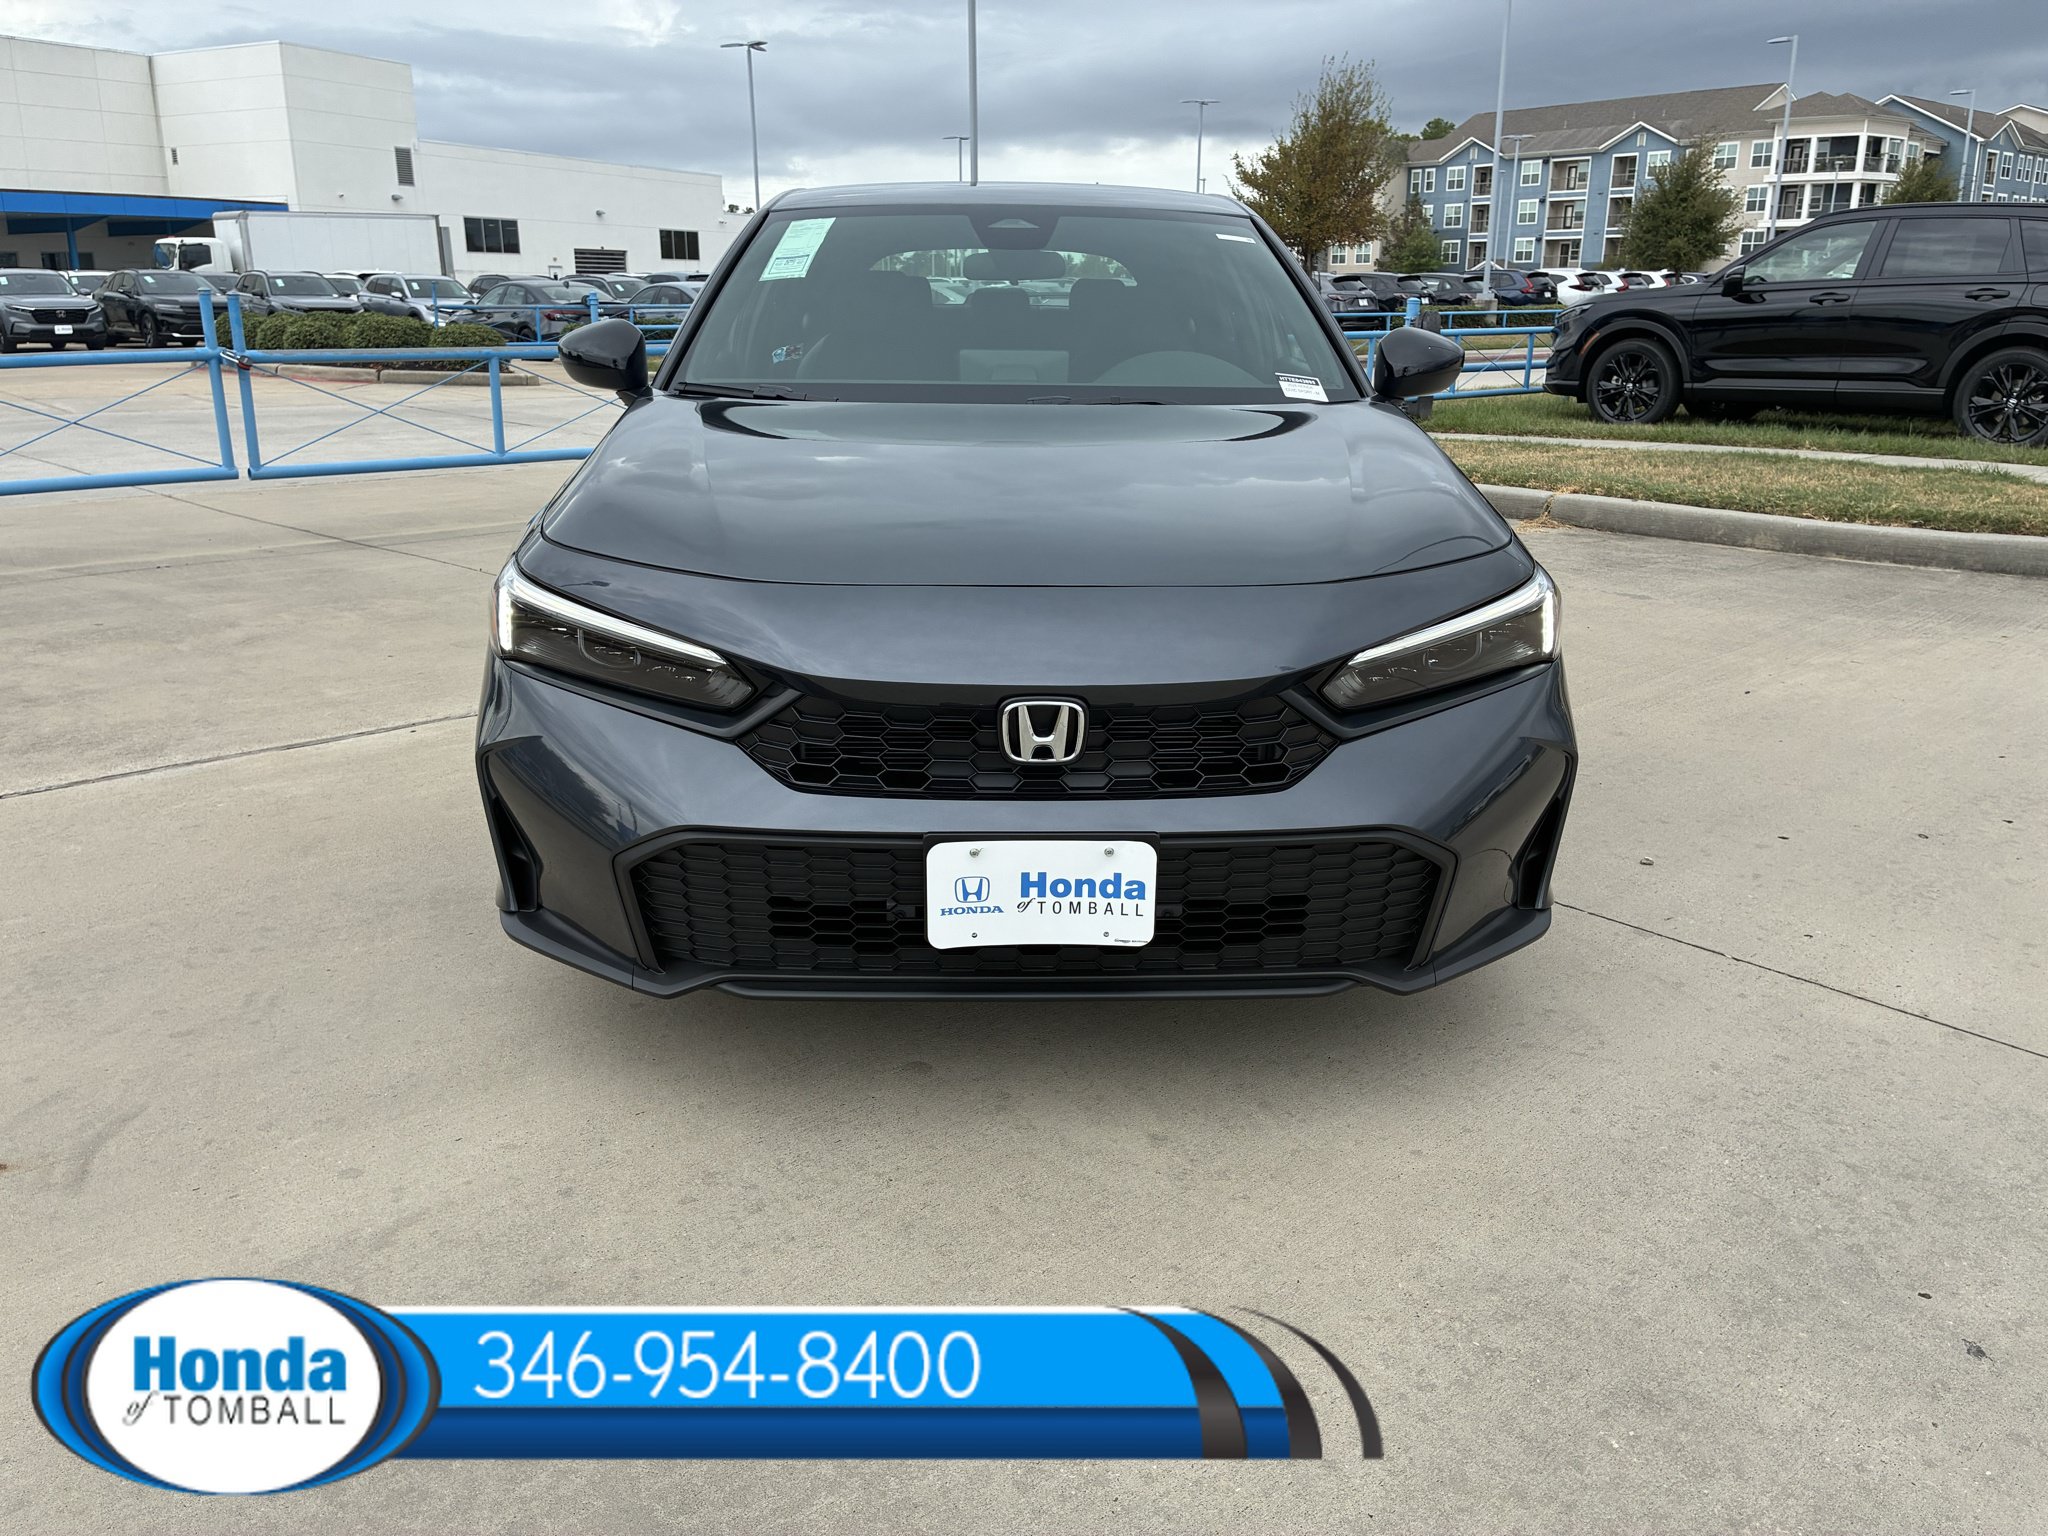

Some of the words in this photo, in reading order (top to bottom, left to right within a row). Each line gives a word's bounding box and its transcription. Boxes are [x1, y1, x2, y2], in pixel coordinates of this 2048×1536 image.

[1020, 871, 1146, 901] Honda
[940, 905, 1004, 917] HONDA
[1016, 897, 1036, 913] of
[1037, 900, 1144, 917] TOMBALL
